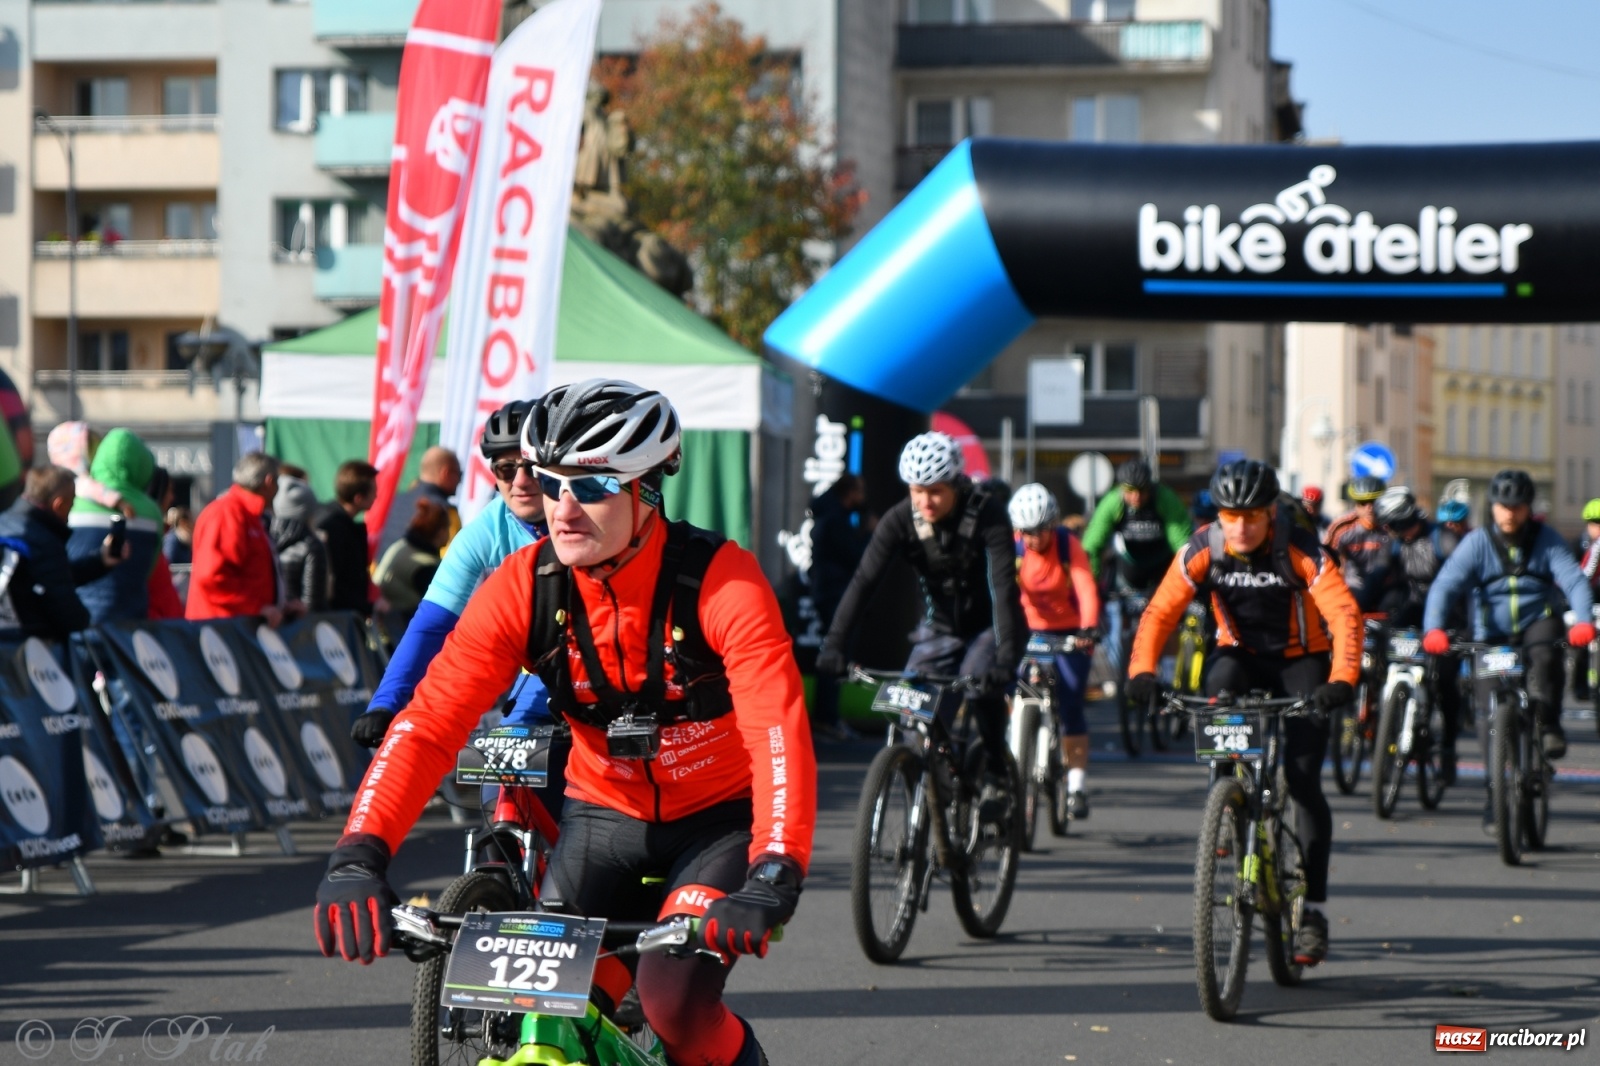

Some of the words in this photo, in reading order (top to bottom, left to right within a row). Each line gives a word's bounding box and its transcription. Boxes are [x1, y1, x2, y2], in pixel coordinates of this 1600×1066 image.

[1138, 203, 1286, 273] bike
[1303, 205, 1533, 274] atelier
[577, 456, 609, 465] uvex
[1204, 725, 1254, 737] OPIEKUN
[1213, 734, 1250, 751] 148
[474, 738, 537, 750] OPIEKUN
[484, 748, 528, 770] 178
[668, 756, 716, 780] Tevere
[771, 756, 787, 786] BIKE
[366, 760, 388, 787] JURA
[356, 788, 375, 815] BIKE
[771, 788, 787, 819] JURA
[475, 936, 577, 959] OPIEKUN
[487, 955, 561, 992] 125
